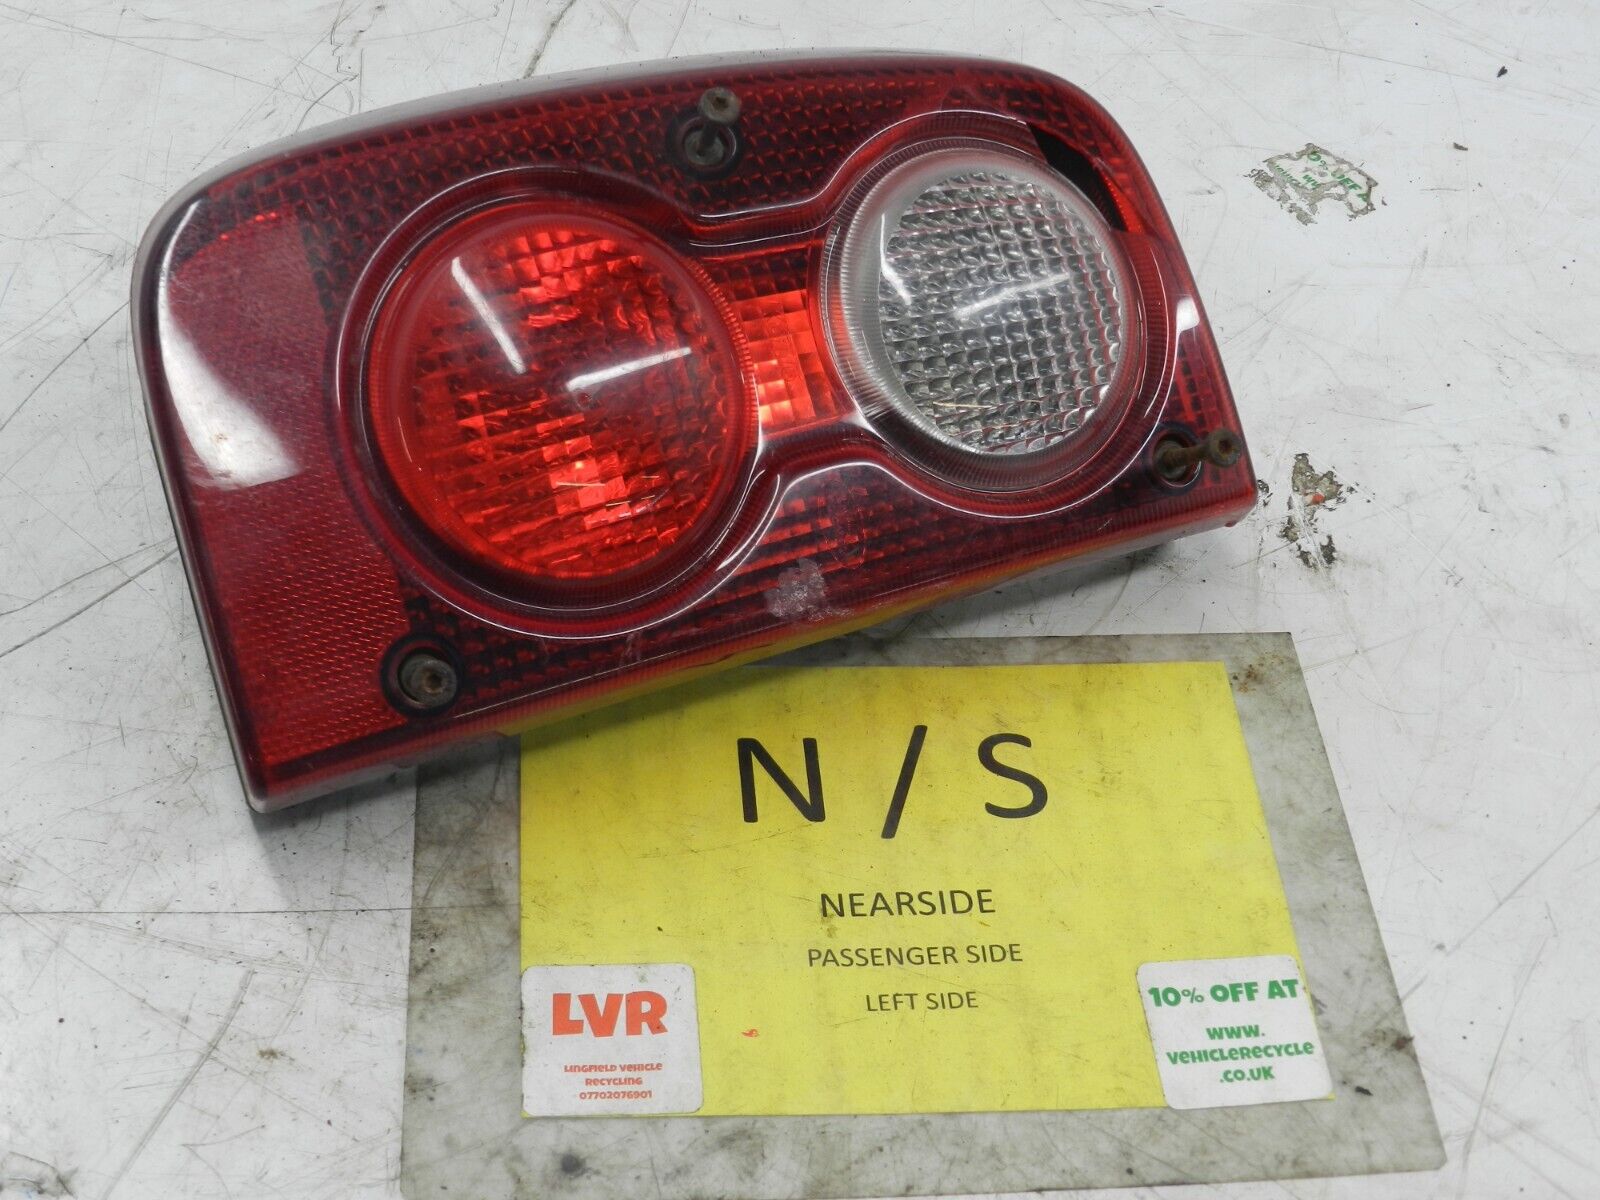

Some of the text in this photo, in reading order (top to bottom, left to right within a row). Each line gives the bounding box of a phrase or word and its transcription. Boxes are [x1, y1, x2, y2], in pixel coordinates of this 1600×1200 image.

[820, 888, 996, 918] NEARSIDE
[807, 943, 1023, 967] PASSENGER SIDE
[865, 991, 979, 1012] LEFT SIDE
[1148, 978, 1299, 1008] 10% OFF AT
[552, 990, 668, 1038] LVR
[1206, 1024, 1265, 1041] WWW.
[1219, 1066, 1275, 1083] .CO.UK
[579, 1090, 653, 1100] 07702076901
